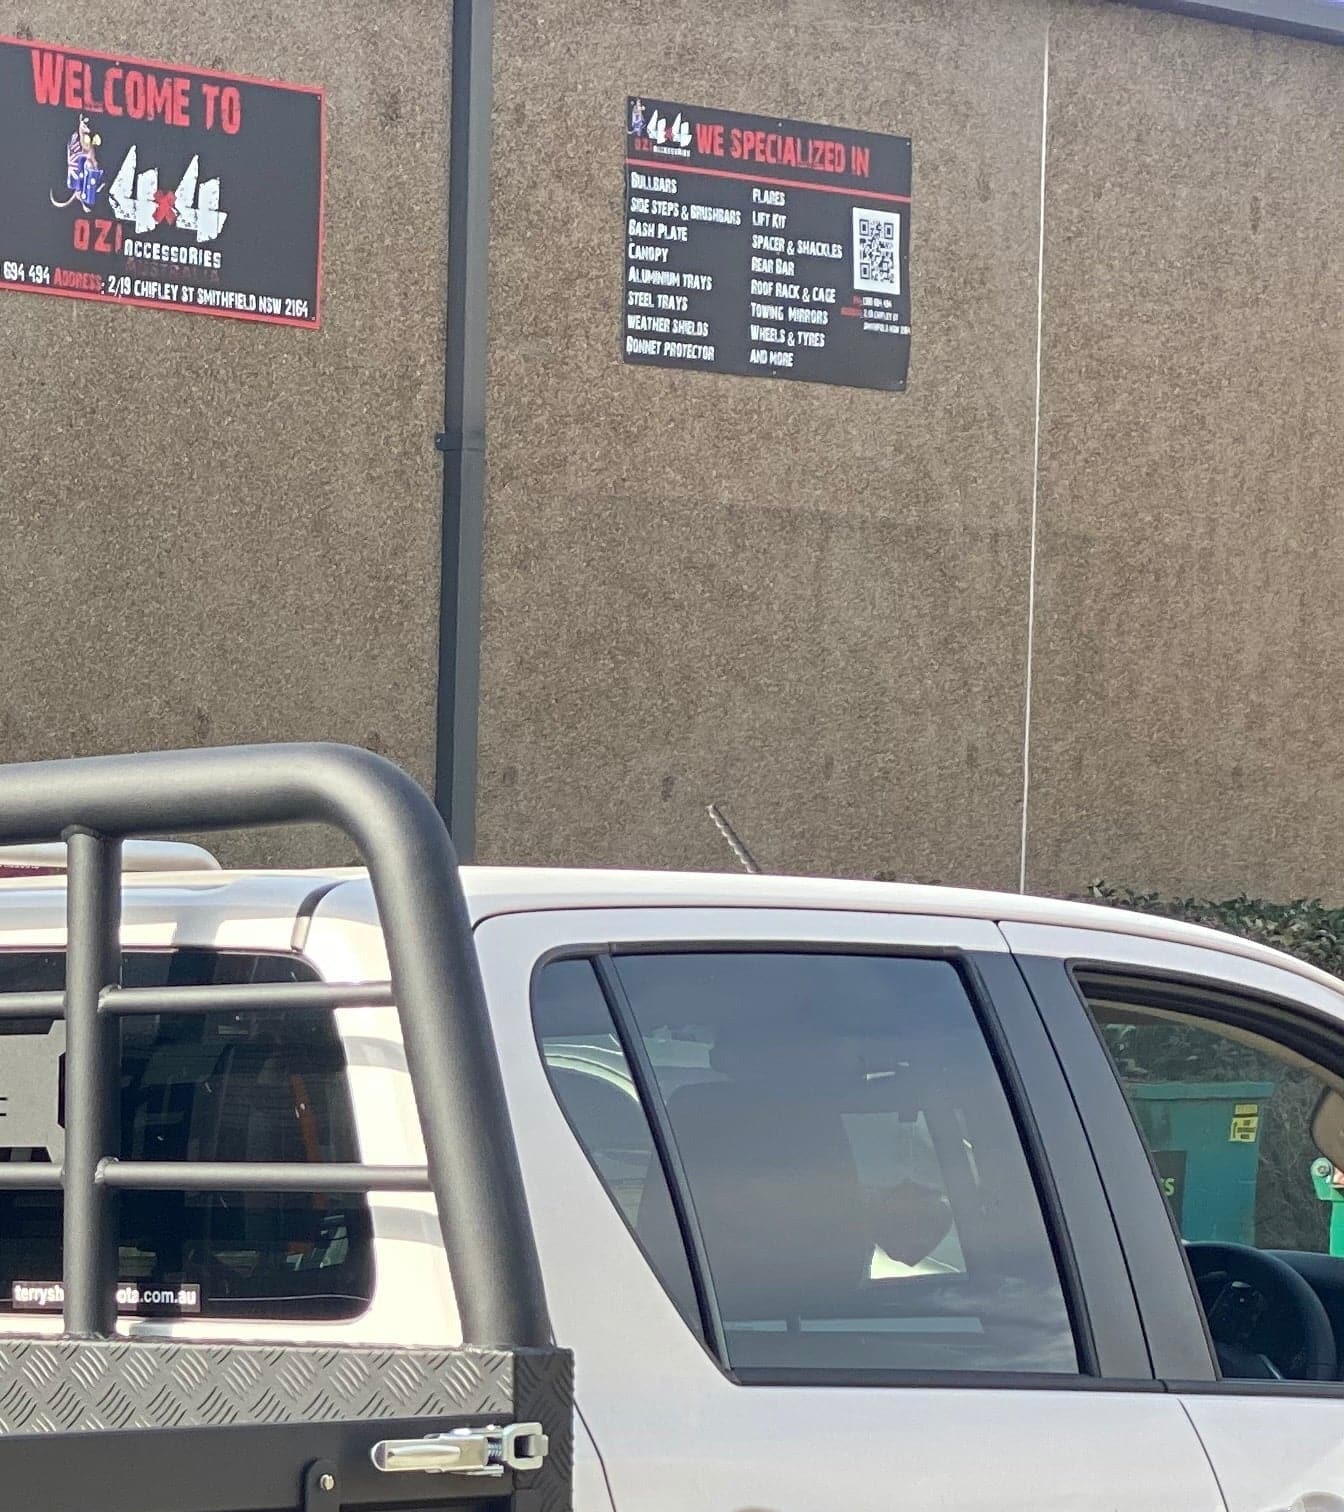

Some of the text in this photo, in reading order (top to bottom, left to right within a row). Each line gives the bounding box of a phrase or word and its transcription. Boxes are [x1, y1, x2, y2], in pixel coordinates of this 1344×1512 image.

[31, 49, 242, 135] WELCOME TO
[696, 122, 870, 178] WE SPECIALIZED IN
[651, 199, 679, 217] STEPS
[681, 205, 689, 221] &
[752, 210, 787, 229] LIFT KIT
[73, 218, 222, 269] OZI ACCESSORIES
[657, 223, 687, 242] PLATE
[628, 242, 669, 262] CANOPY
[752, 234, 843, 259] SPACER & SHACKLES
[3, 261, 25, 281] 694
[28, 265, 50, 284] 494
[107, 274, 131, 298] 2/19
[133, 279, 179, 302] CHIFLEY
[181, 286, 194, 303] ST
[197, 287, 256, 312] SMITHFIELD
[258, 295, 282, 315] NSW
[284, 298, 308, 318] 2164
[682, 273, 713, 291] TRAYS
[627, 290, 688, 311] STEEL TRAYS
[802, 287, 811, 303] &
[812, 286, 836, 303] CAGE
[750, 302, 784, 321] TOWING
[788, 306, 828, 325] MIRRORS
[627, 314, 709, 337] WEATHER SHIELDS
[750, 324, 825, 348] WHEELS & TYRES
[663, 341, 715, 361] PROTECTOR
[750, 348, 794, 367] AND MORE
